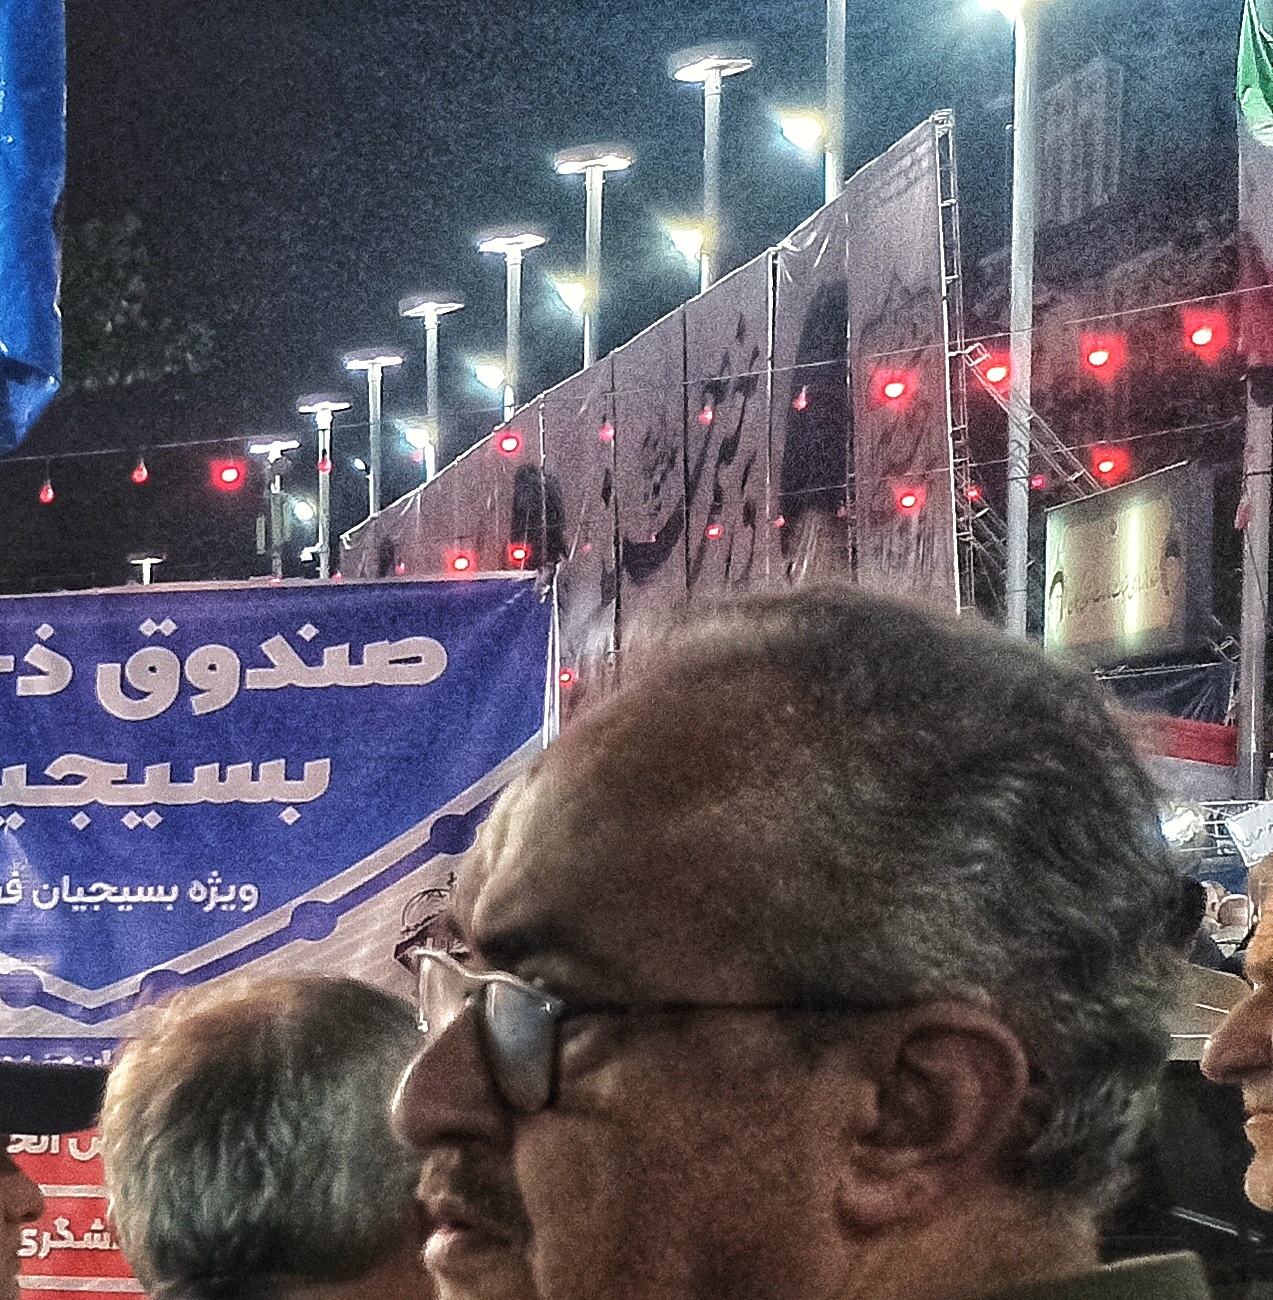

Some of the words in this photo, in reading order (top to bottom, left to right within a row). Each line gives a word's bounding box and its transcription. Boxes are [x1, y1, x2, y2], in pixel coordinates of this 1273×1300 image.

[96, 618, 447, 721] صندوق
[32, 875, 179, 912] بسیجیان
[189, 870, 259, 912] ویژه
